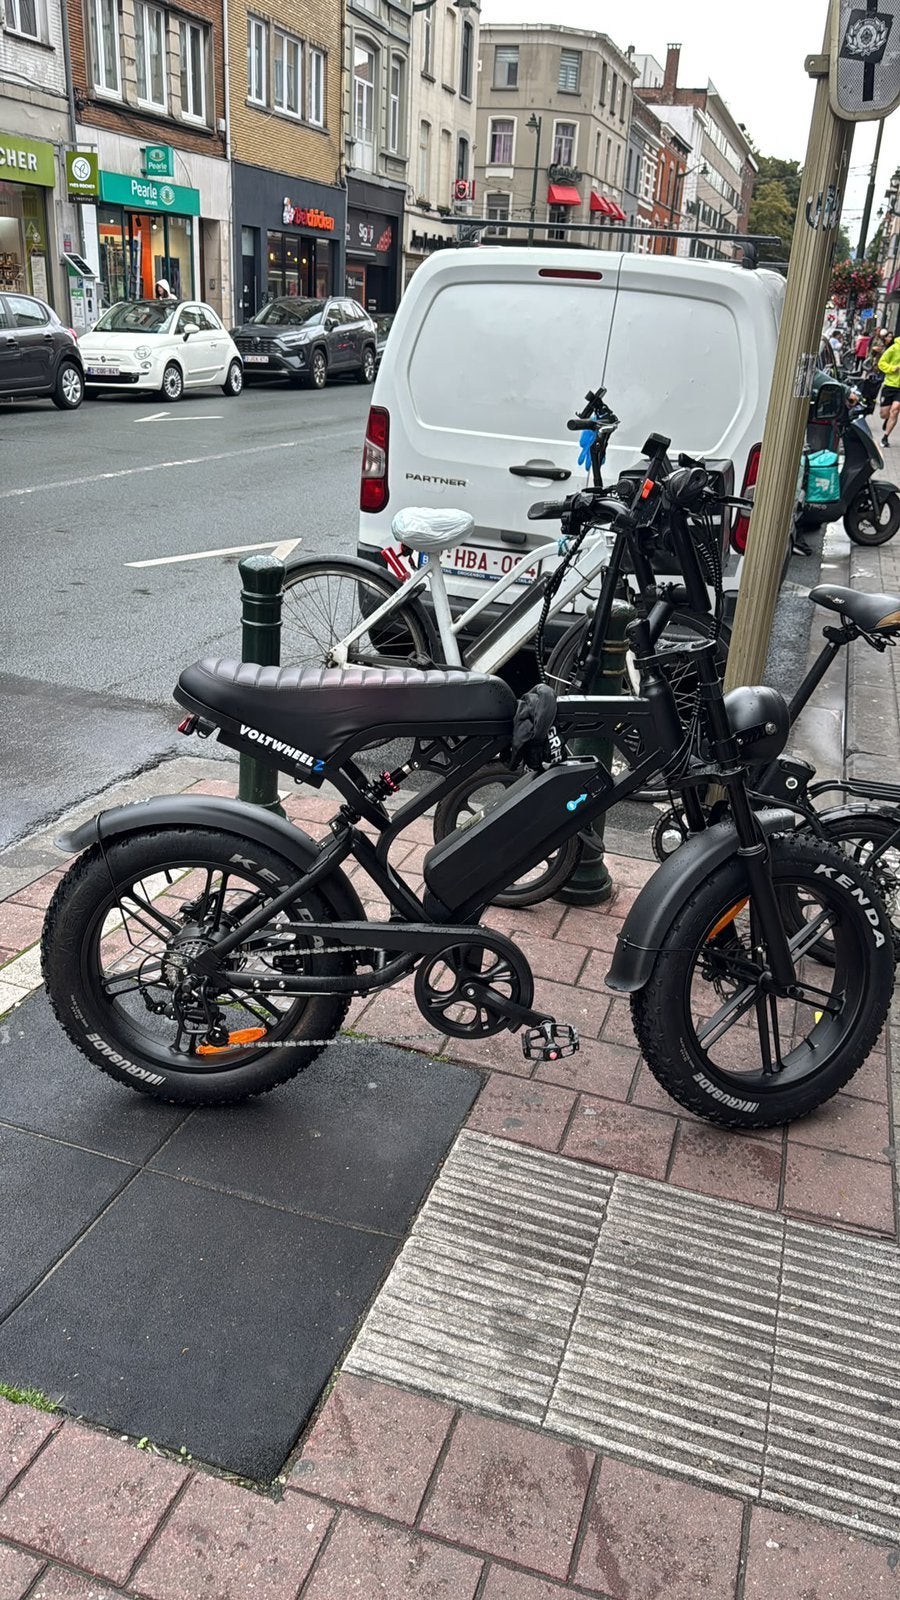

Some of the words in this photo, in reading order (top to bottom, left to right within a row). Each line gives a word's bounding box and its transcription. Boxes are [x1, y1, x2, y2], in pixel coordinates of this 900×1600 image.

[131, 180, 158, 199] Pearle
[405, 472, 466, 487] PARTNER
[813, 864, 886, 948] KENDA
[86, 1033, 152, 1080] KRUSADE
[692, 1072, 747, 1111] KRUSADE
